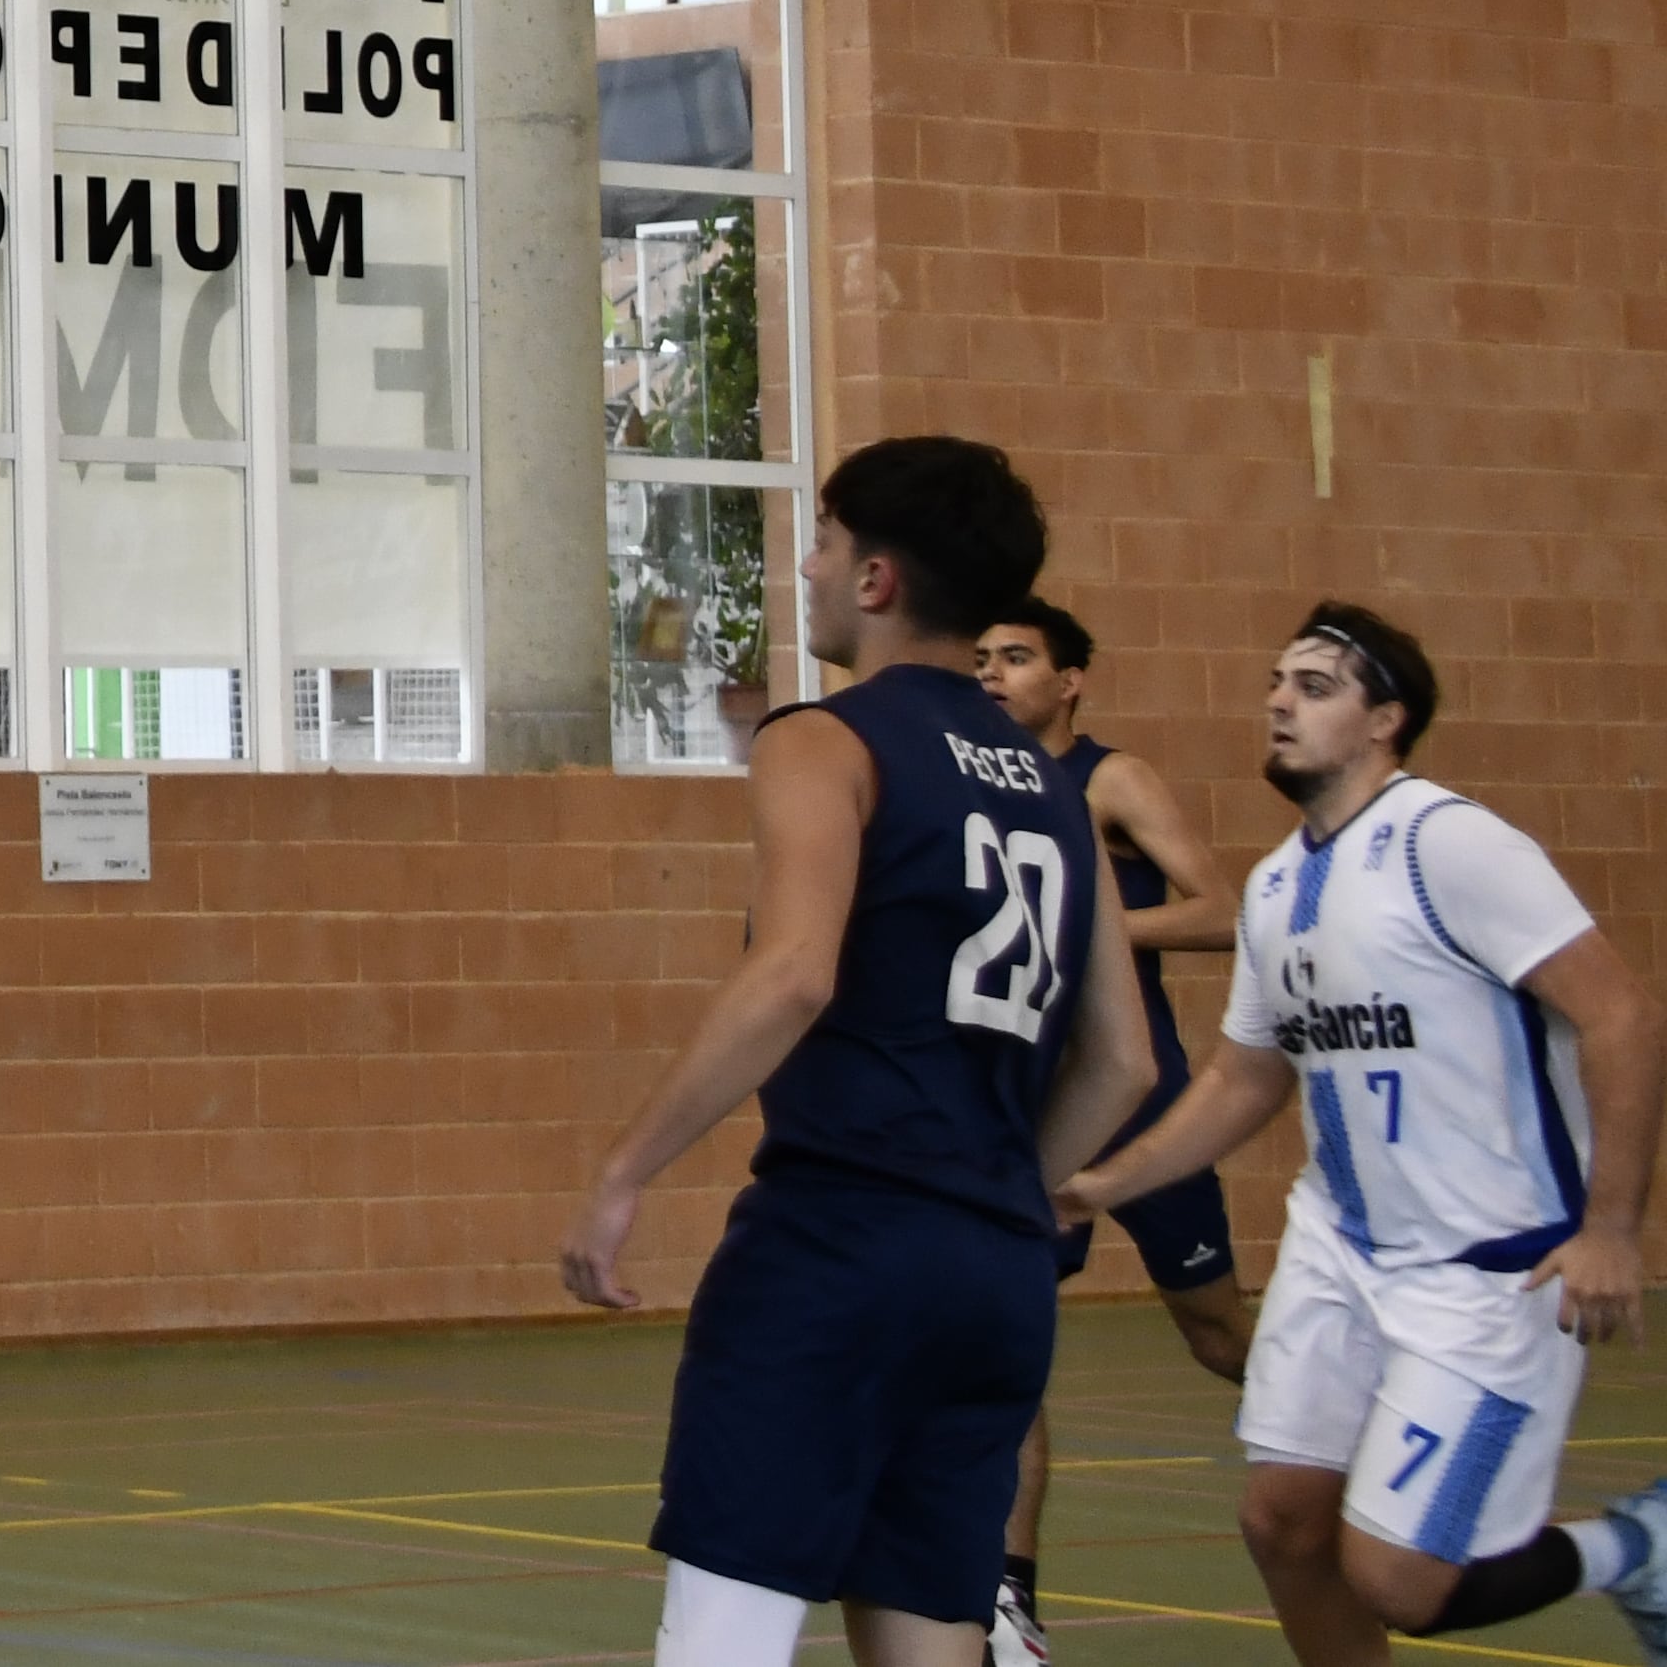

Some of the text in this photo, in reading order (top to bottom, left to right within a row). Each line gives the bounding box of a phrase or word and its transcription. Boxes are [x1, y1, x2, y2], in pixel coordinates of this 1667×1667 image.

[943, 732, 1044, 794] PECES
[945, 811, 1064, 1045] 20
[1365, 1069, 1403, 1144] 7
[1388, 1421, 1442, 1493] 7
